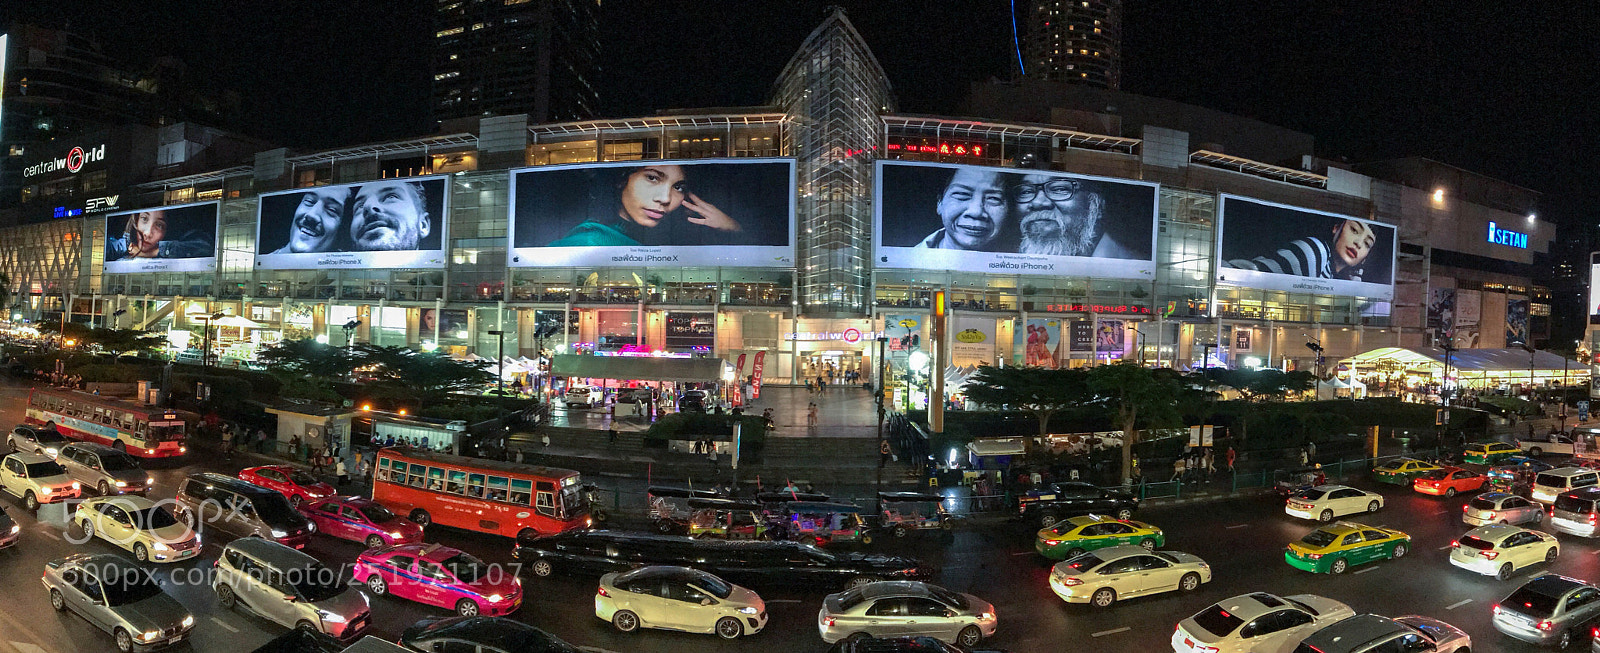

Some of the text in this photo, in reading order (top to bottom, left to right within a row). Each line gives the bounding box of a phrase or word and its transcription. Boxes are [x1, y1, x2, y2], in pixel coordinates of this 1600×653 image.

[23, 143, 105, 178] centralworld
[1488, 221, 1528, 249] ISETAN
[644, 254, 672, 262] iPhone
[672, 254, 679, 262] X
[1020, 262, 1048, 270] iPhone
[783, 327, 885, 345] centralworld
